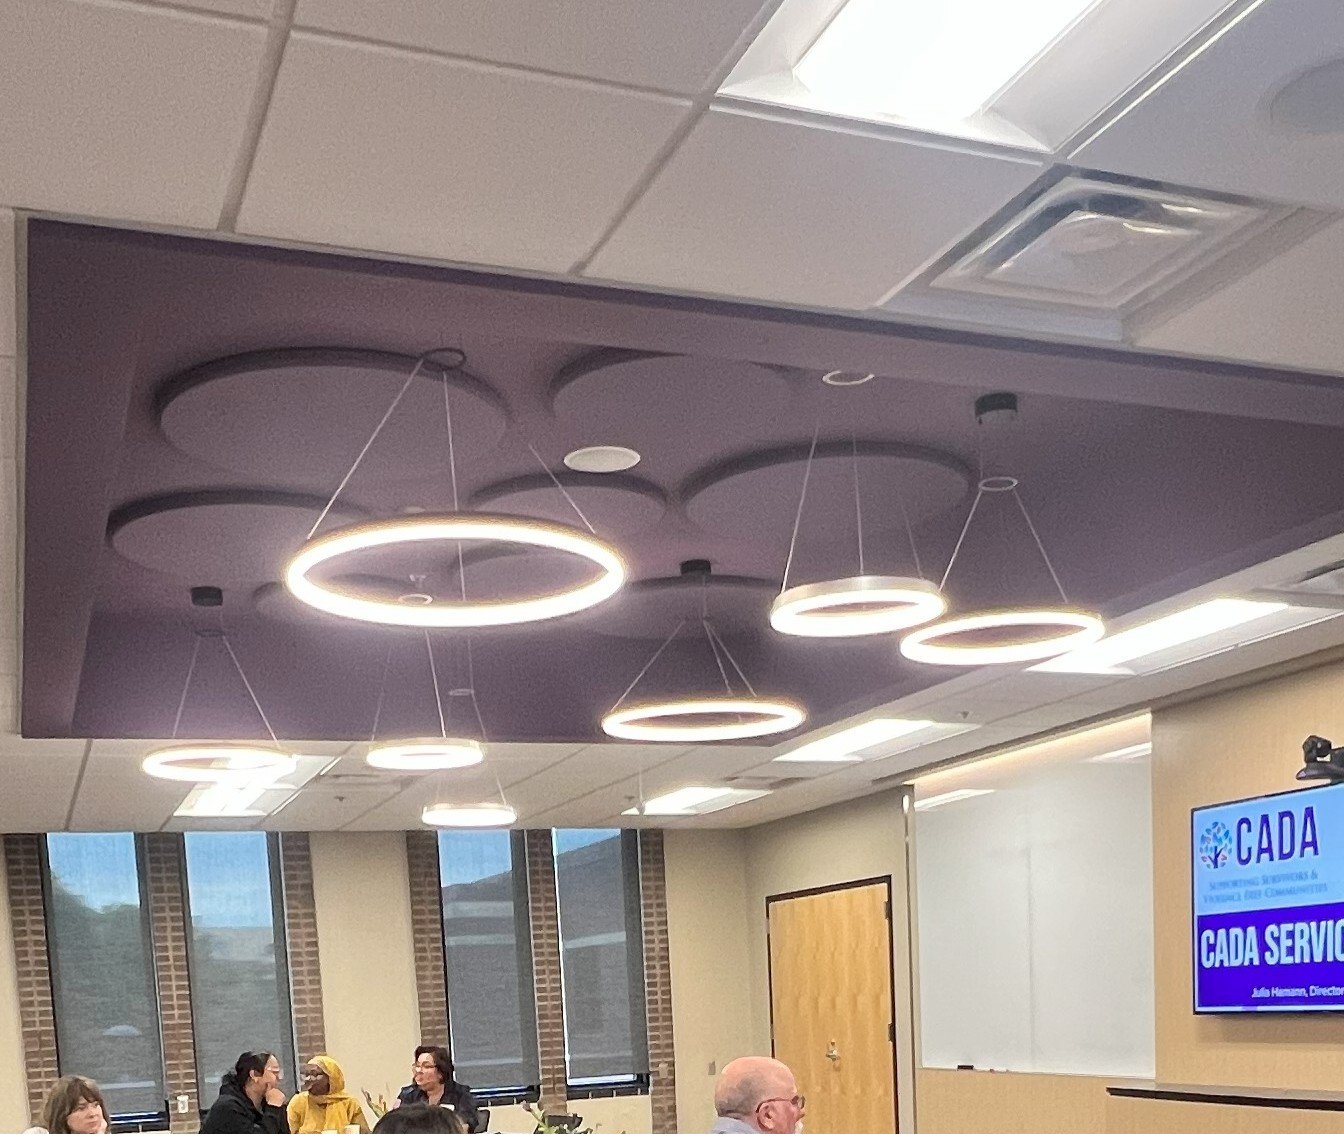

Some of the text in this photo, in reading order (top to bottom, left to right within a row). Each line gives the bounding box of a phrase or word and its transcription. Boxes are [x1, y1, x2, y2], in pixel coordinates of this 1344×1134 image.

[1236, 806, 1319, 866] CADA
[1200, 926, 1260, 969] CADA
[1309, 985, 1344, 996] Director
